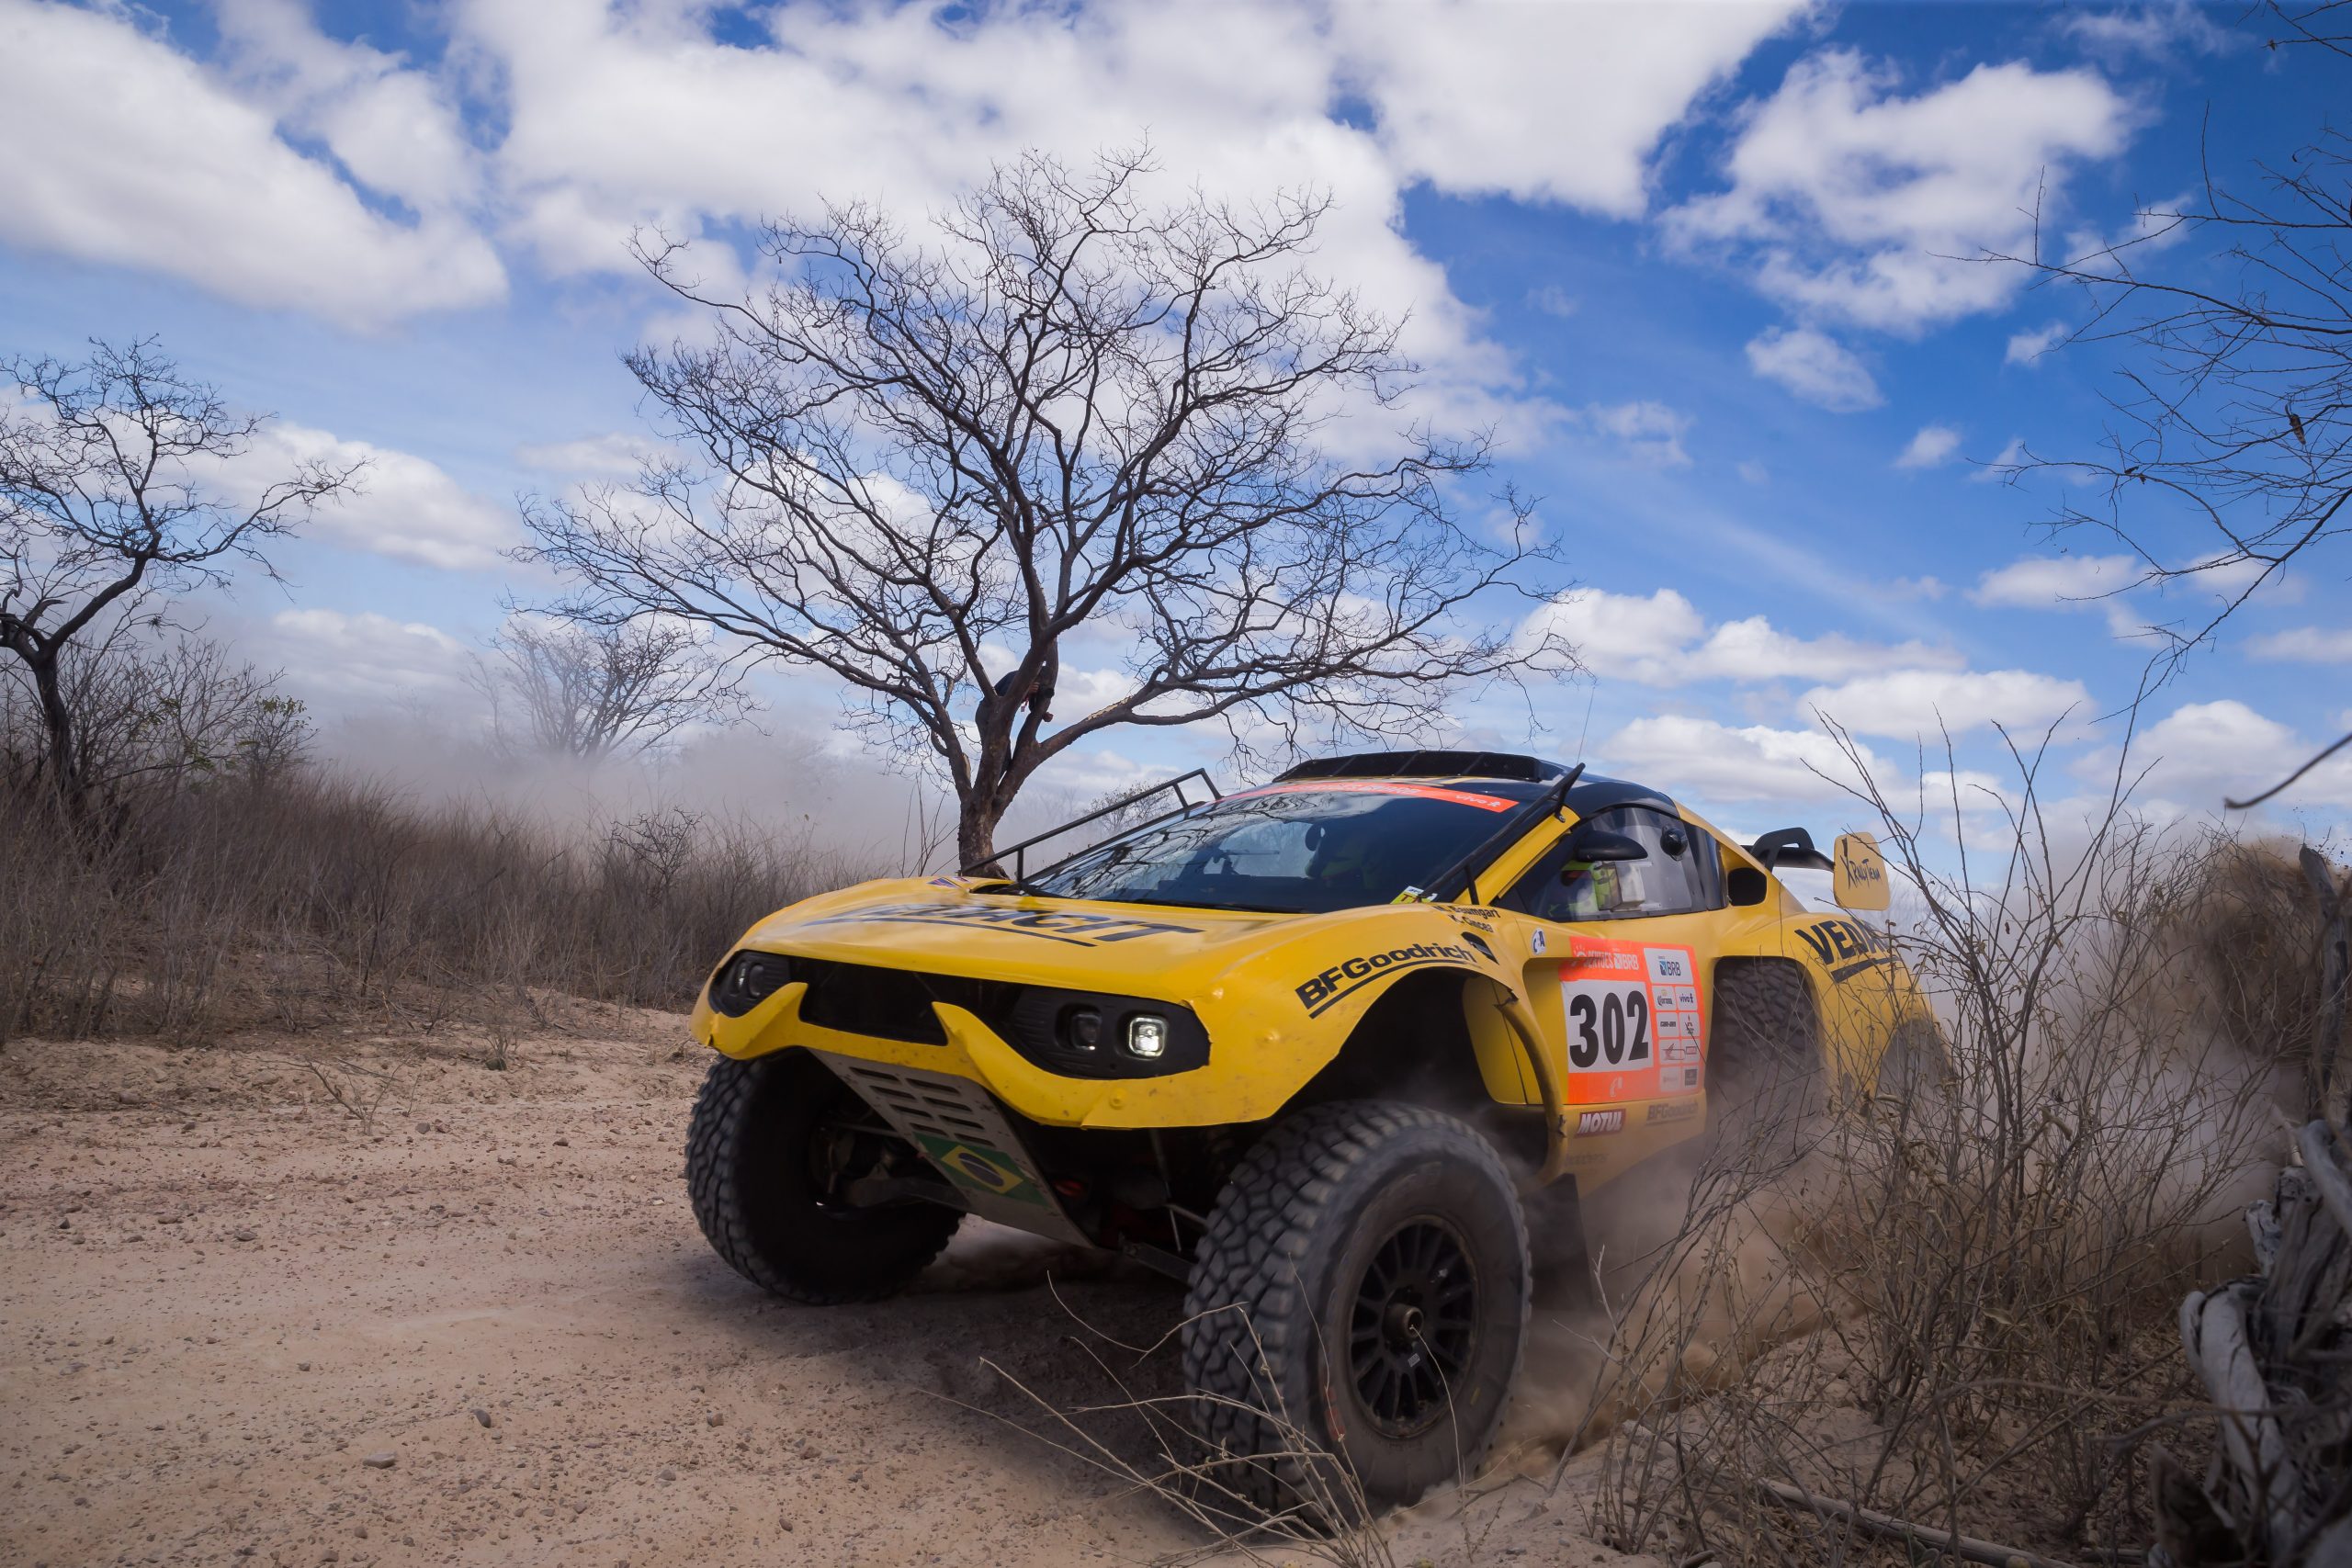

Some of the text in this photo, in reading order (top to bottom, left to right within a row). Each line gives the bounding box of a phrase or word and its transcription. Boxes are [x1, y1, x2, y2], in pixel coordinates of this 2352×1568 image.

[1447, 905, 1501, 920] Baumgart
[1294, 942, 1478, 1010] BFGoodrich
[1667, 962, 1681, 976] BRB
[1569, 989, 1649, 1068] 302
[1577, 1111, 1623, 1134] MOTUL
